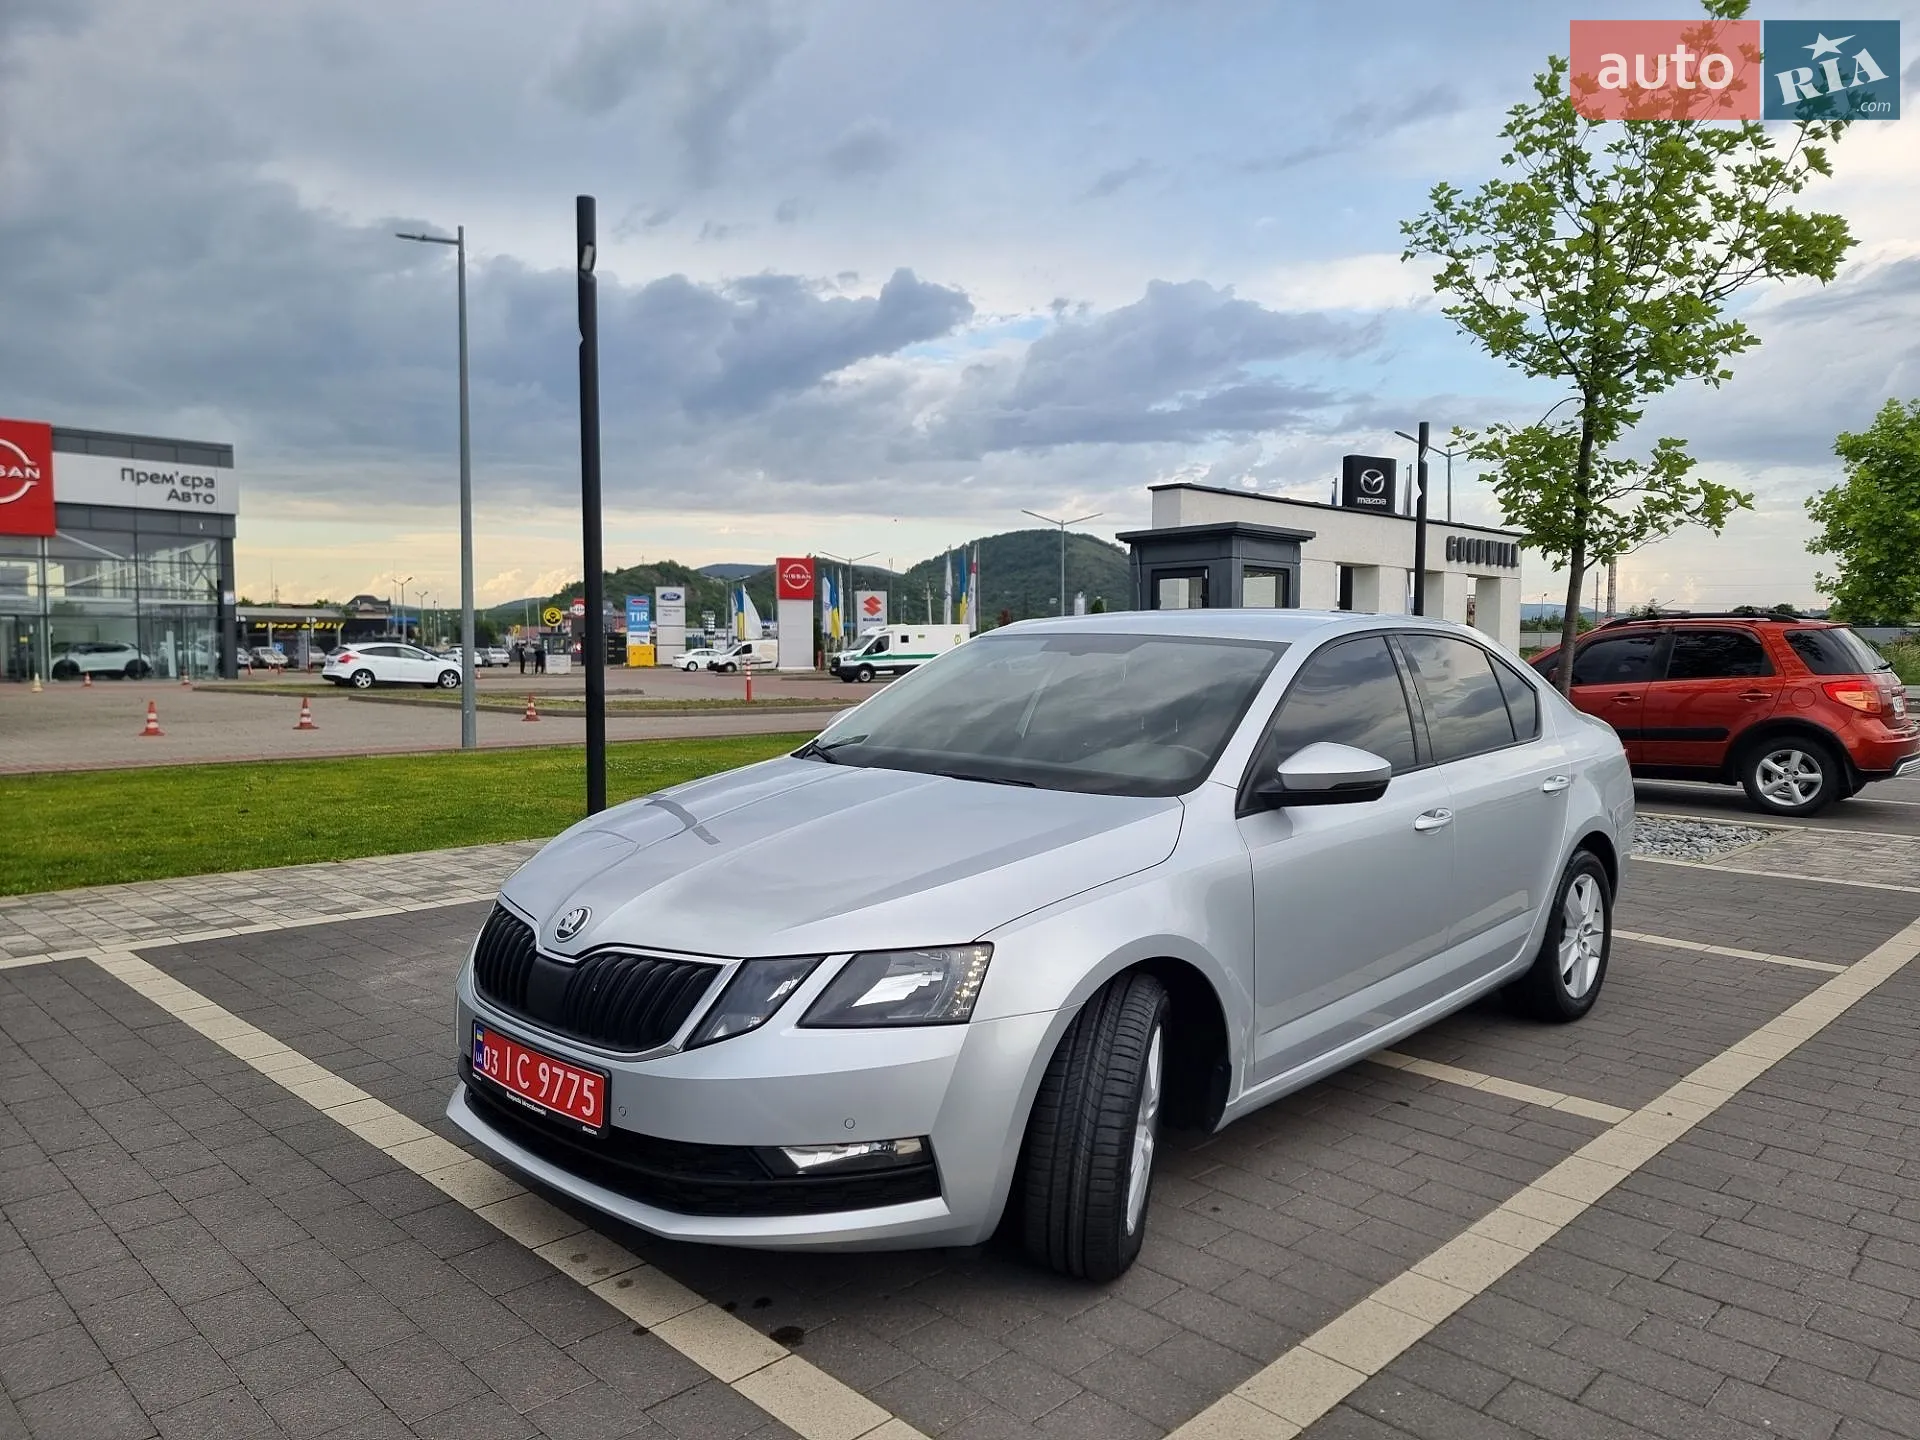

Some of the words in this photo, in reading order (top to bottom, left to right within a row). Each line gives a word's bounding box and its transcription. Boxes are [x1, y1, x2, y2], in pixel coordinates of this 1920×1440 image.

[120, 467, 215, 489] Прем'єра
[166, 487, 216, 505] Авто
[1357, 496, 1387, 506] mazda
[1446, 535, 1519, 568] GOODWILL
[629, 611, 648, 622] TIR
[483, 1045, 498, 1075] 03
[506, 1046, 530, 1089] IC
[538, 1062, 595, 1116] 9775
